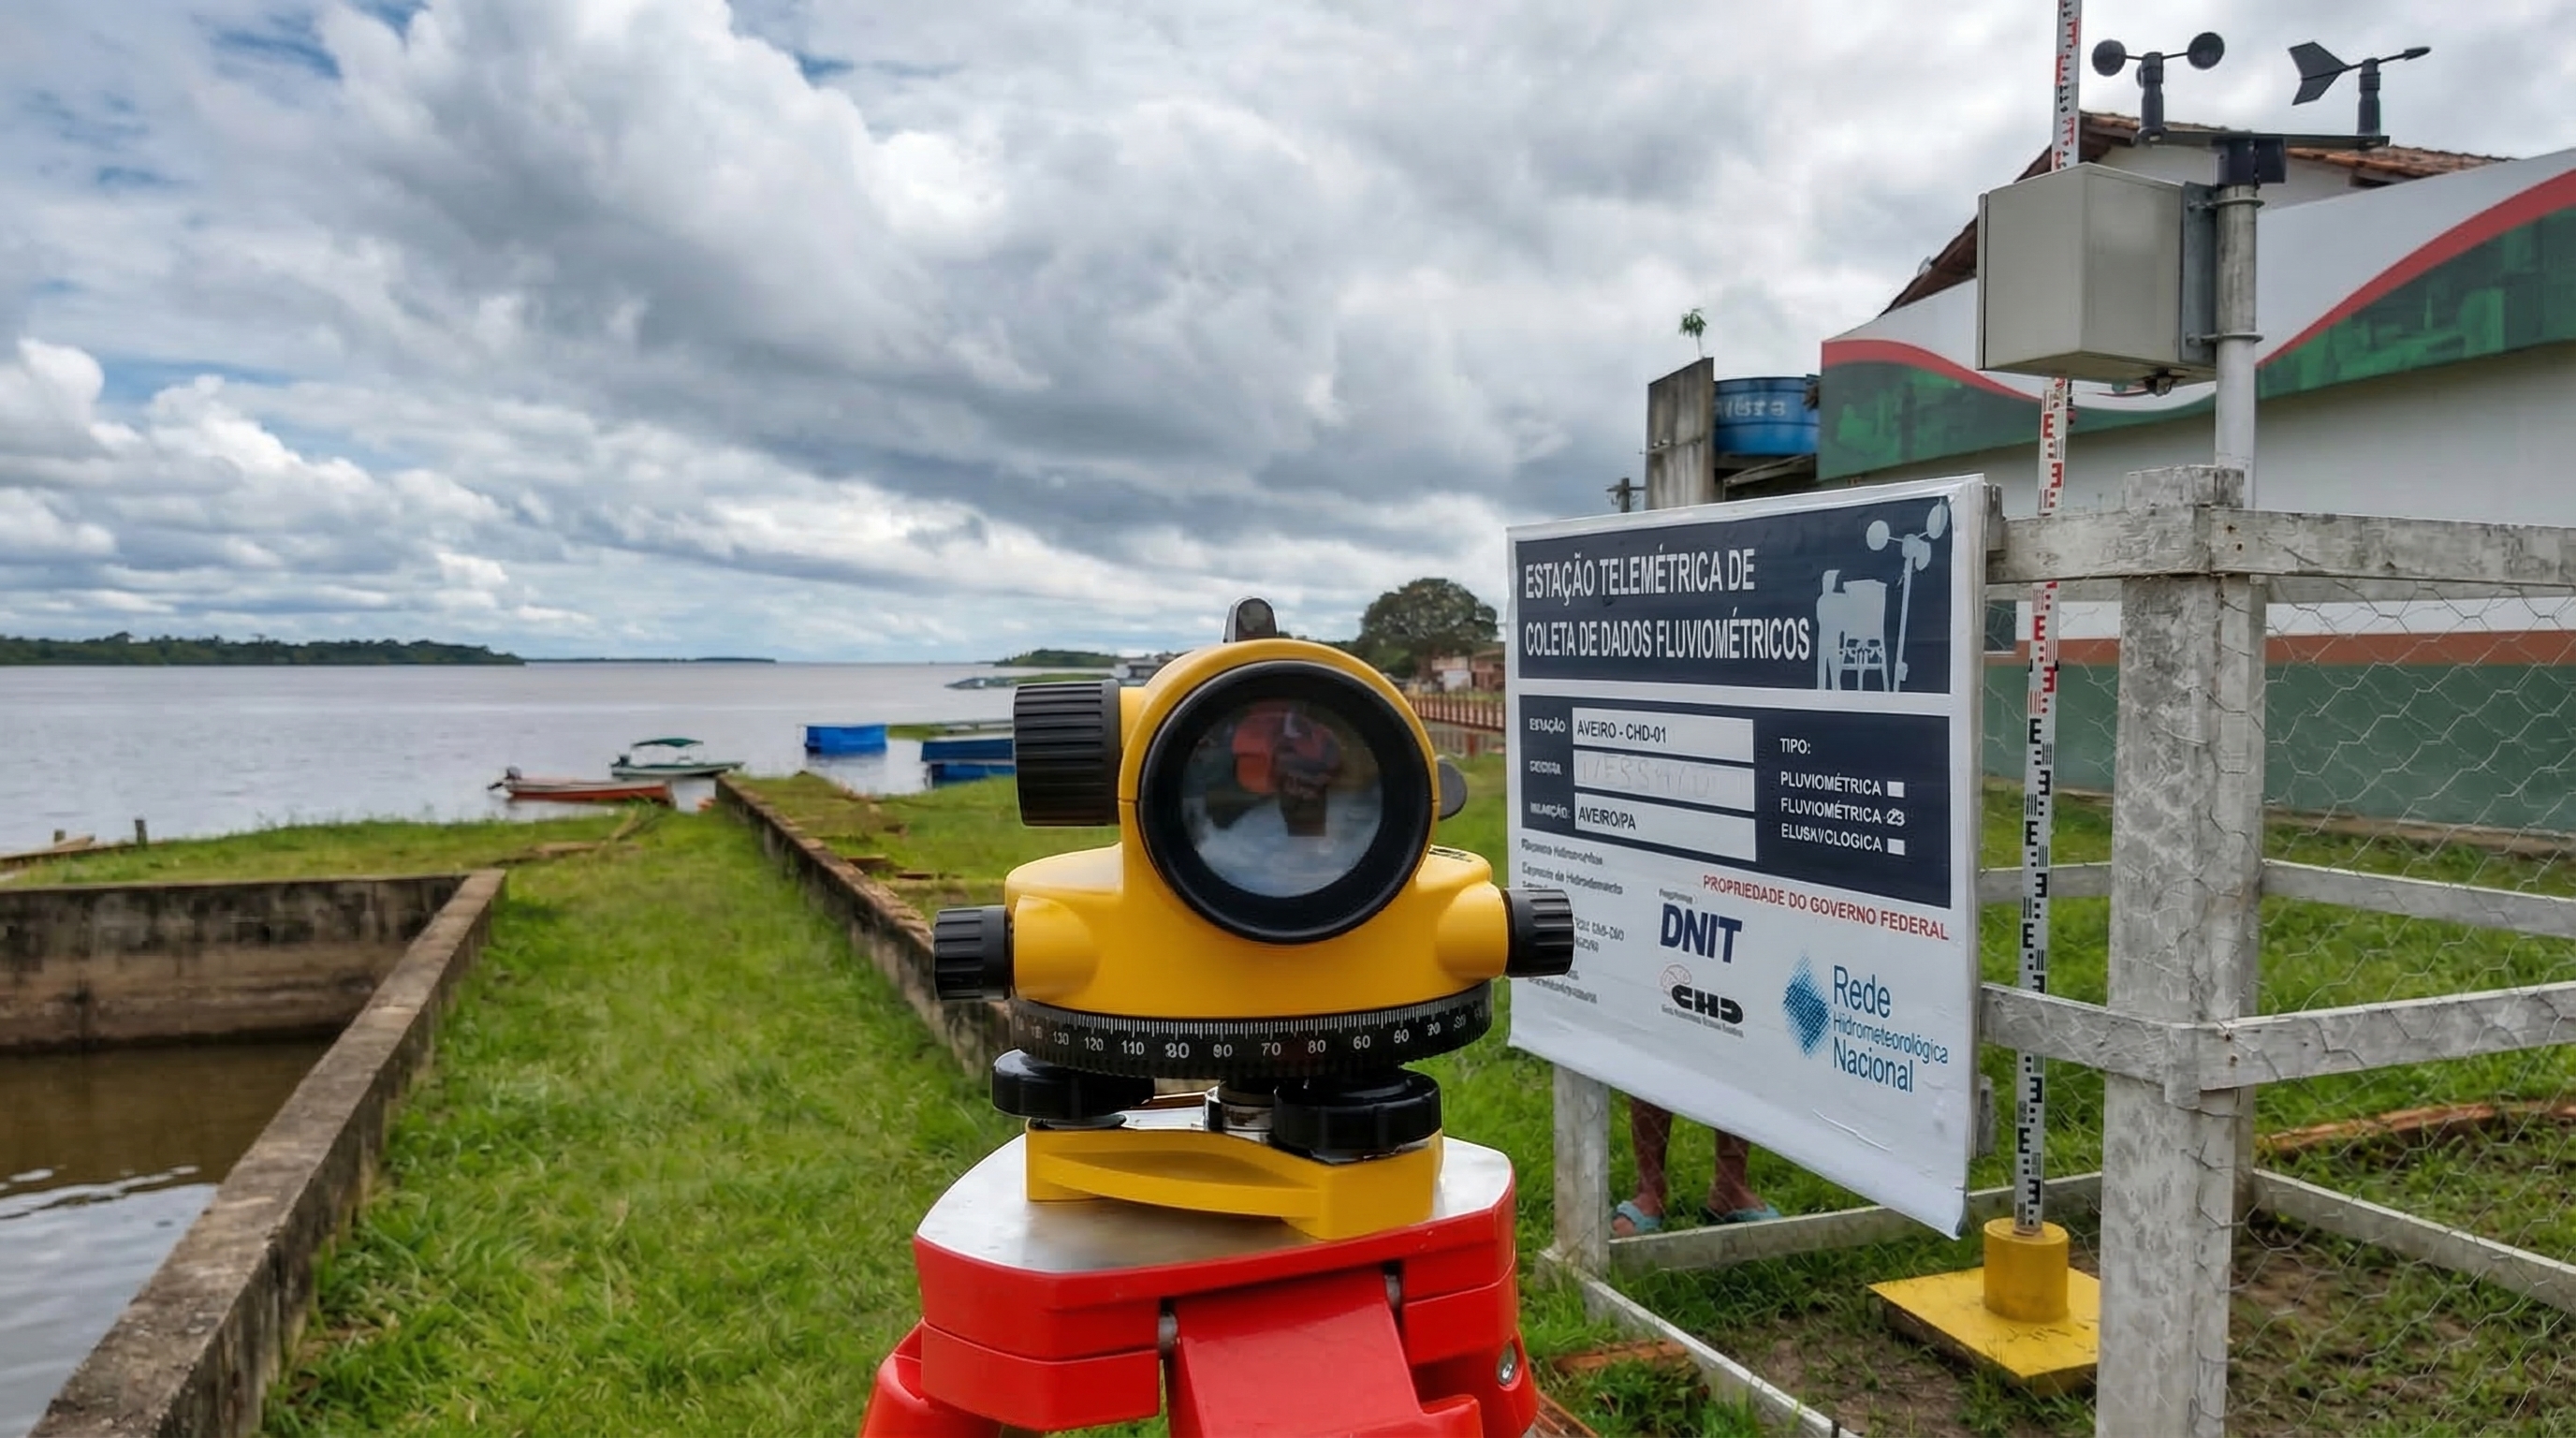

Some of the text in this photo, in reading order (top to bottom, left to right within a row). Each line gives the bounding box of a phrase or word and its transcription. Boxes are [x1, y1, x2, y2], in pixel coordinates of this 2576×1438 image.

[1526, 543, 1755, 607] ESTAÇÃO TELEMÉTRICA DE
[1526, 607, 1810, 661] COLETA DE DADOS FLUVIOMÉTRICOS
[1577, 720, 1617, 739] AVEIRO
[1626, 724, 1667, 743] CHD-01
[1779, 738, 1811, 755] TIPO:
[1780, 772, 1881, 796] PLUVIOMÉTRICA
[1578, 806, 1636, 830] AVEIRO/PA
[1780, 798, 1882, 824] FLUVIOMÉTRICA
[1704, 875, 1785, 906] PROPRIEDADE
[1789, 892, 1807, 910] DO
[1810, 897, 1876, 925] GOVERNO
[1881, 911, 1949, 941] FEDERAL
[1661, 902, 1743, 963] DNIT
[1834, 965, 1891, 1019] Rede
[1085, 1036, 1104, 1052] 120
[1261, 1043, 1281, 1057] 70
[1353, 1034, 1371, 1049] 60
[1834, 1036, 1913, 1093] Nacional
